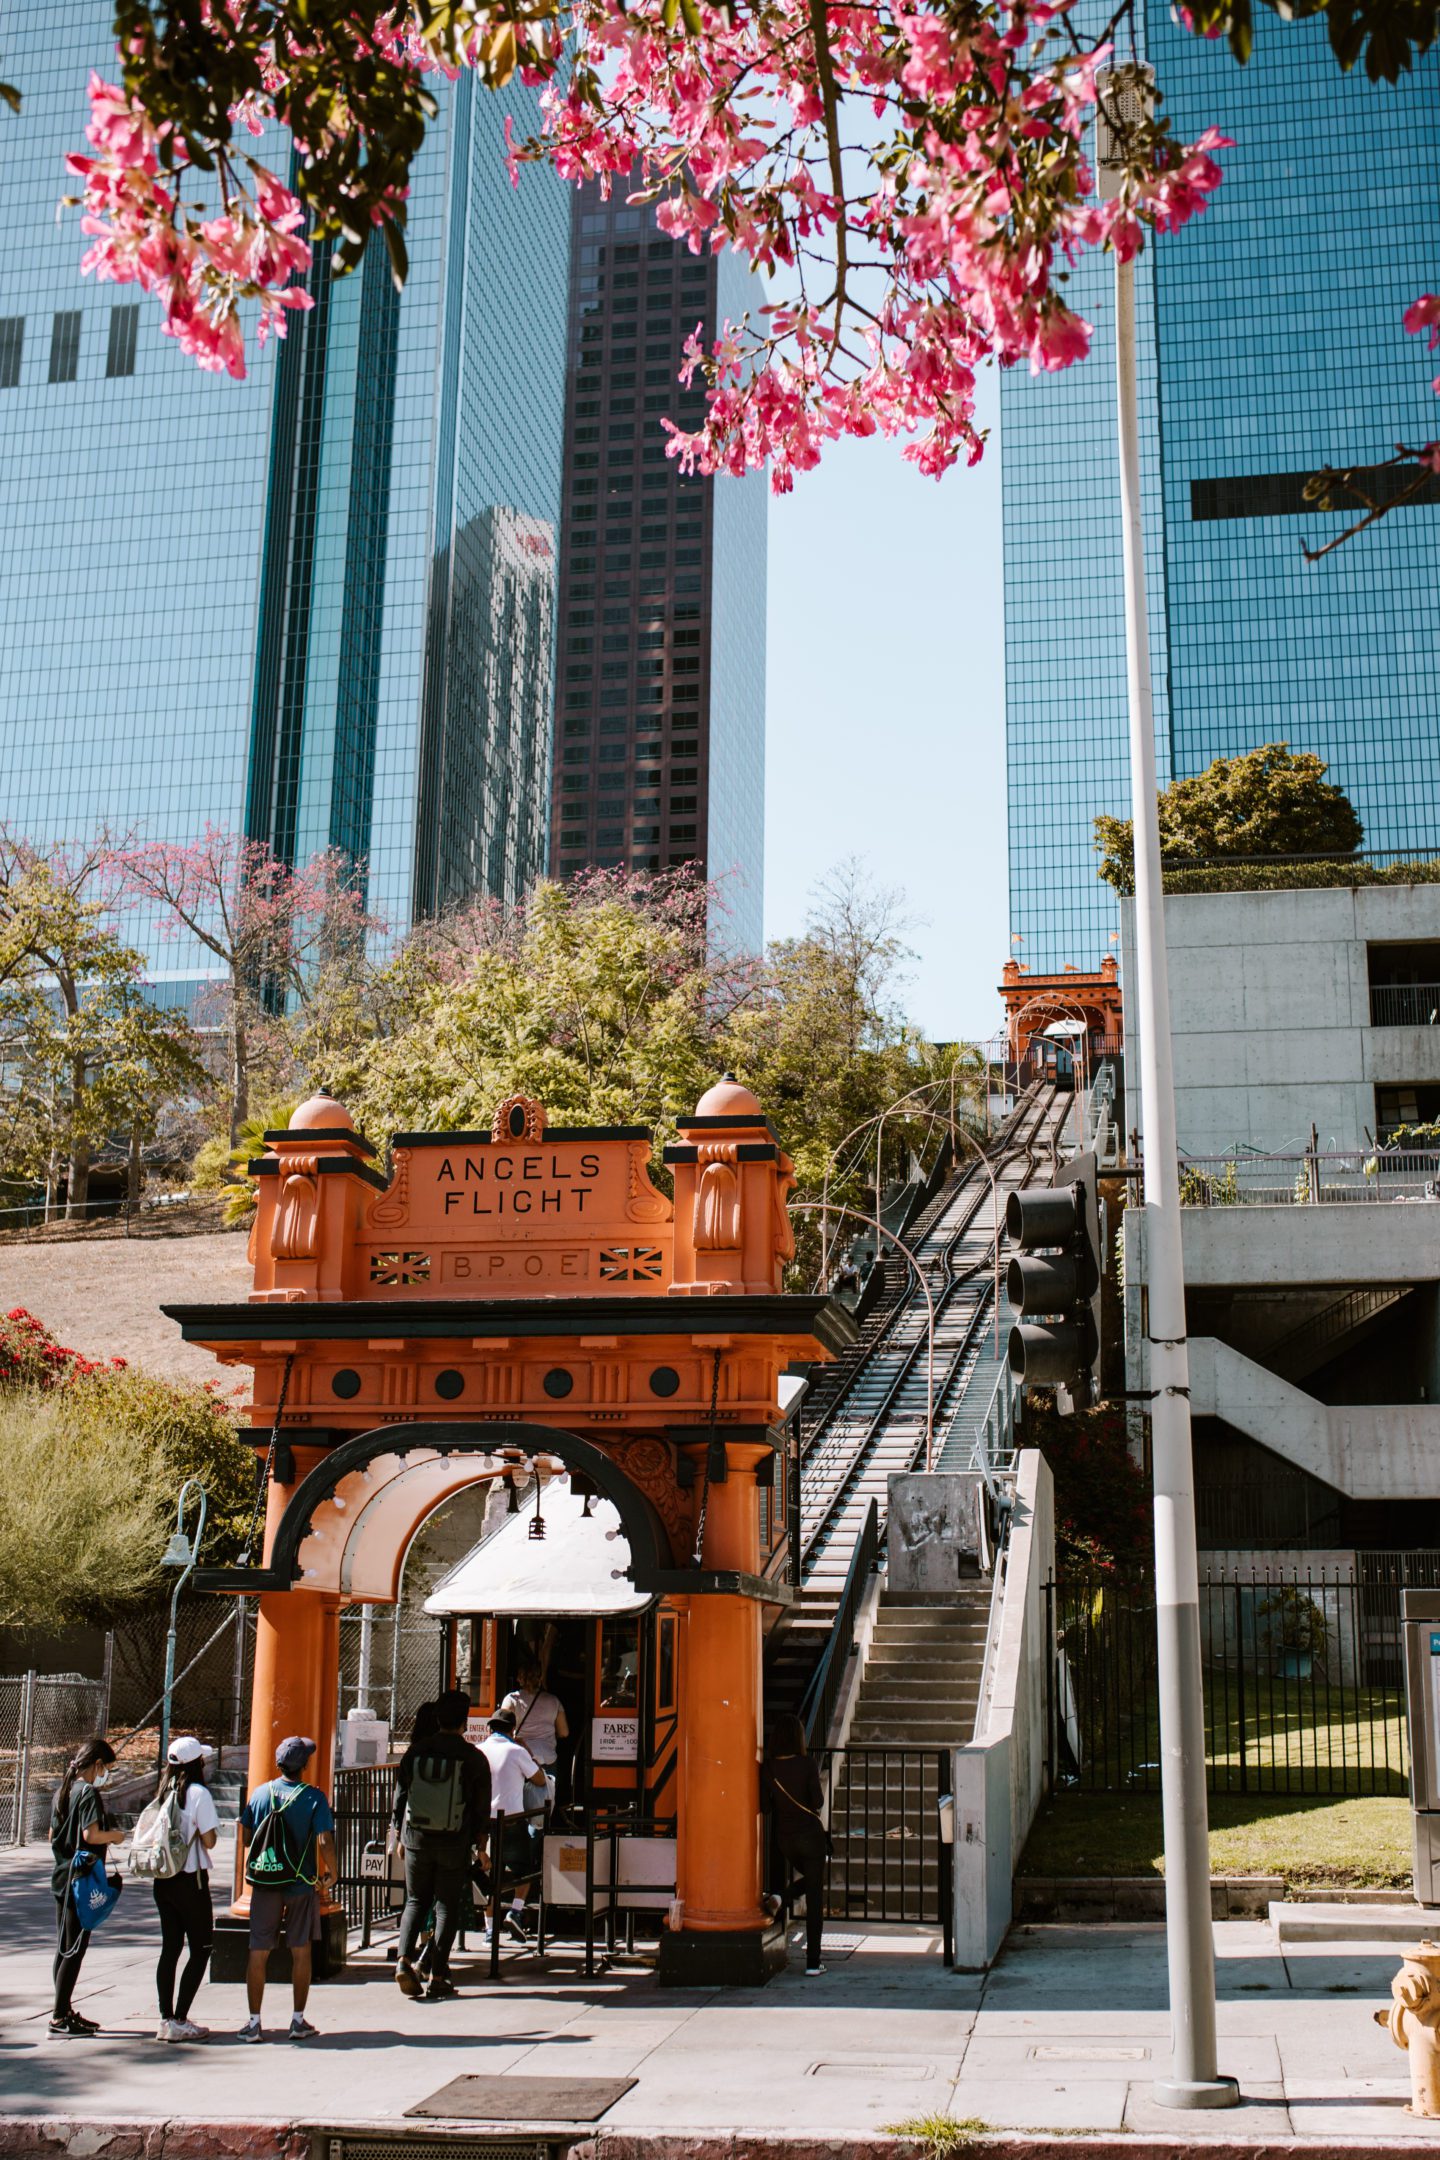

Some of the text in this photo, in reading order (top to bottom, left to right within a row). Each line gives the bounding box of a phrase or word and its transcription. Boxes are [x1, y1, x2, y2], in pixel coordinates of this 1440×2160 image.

[436, 1154, 600, 1182] ANGELS
[444, 1188, 593, 1215] FLIGHT
[469, 1724, 485, 1732] ENTER
[603, 1723, 636, 1734] FARES
[249, 1860, 284, 1872] adidas
[365, 1859, 384, 1871] PAY
